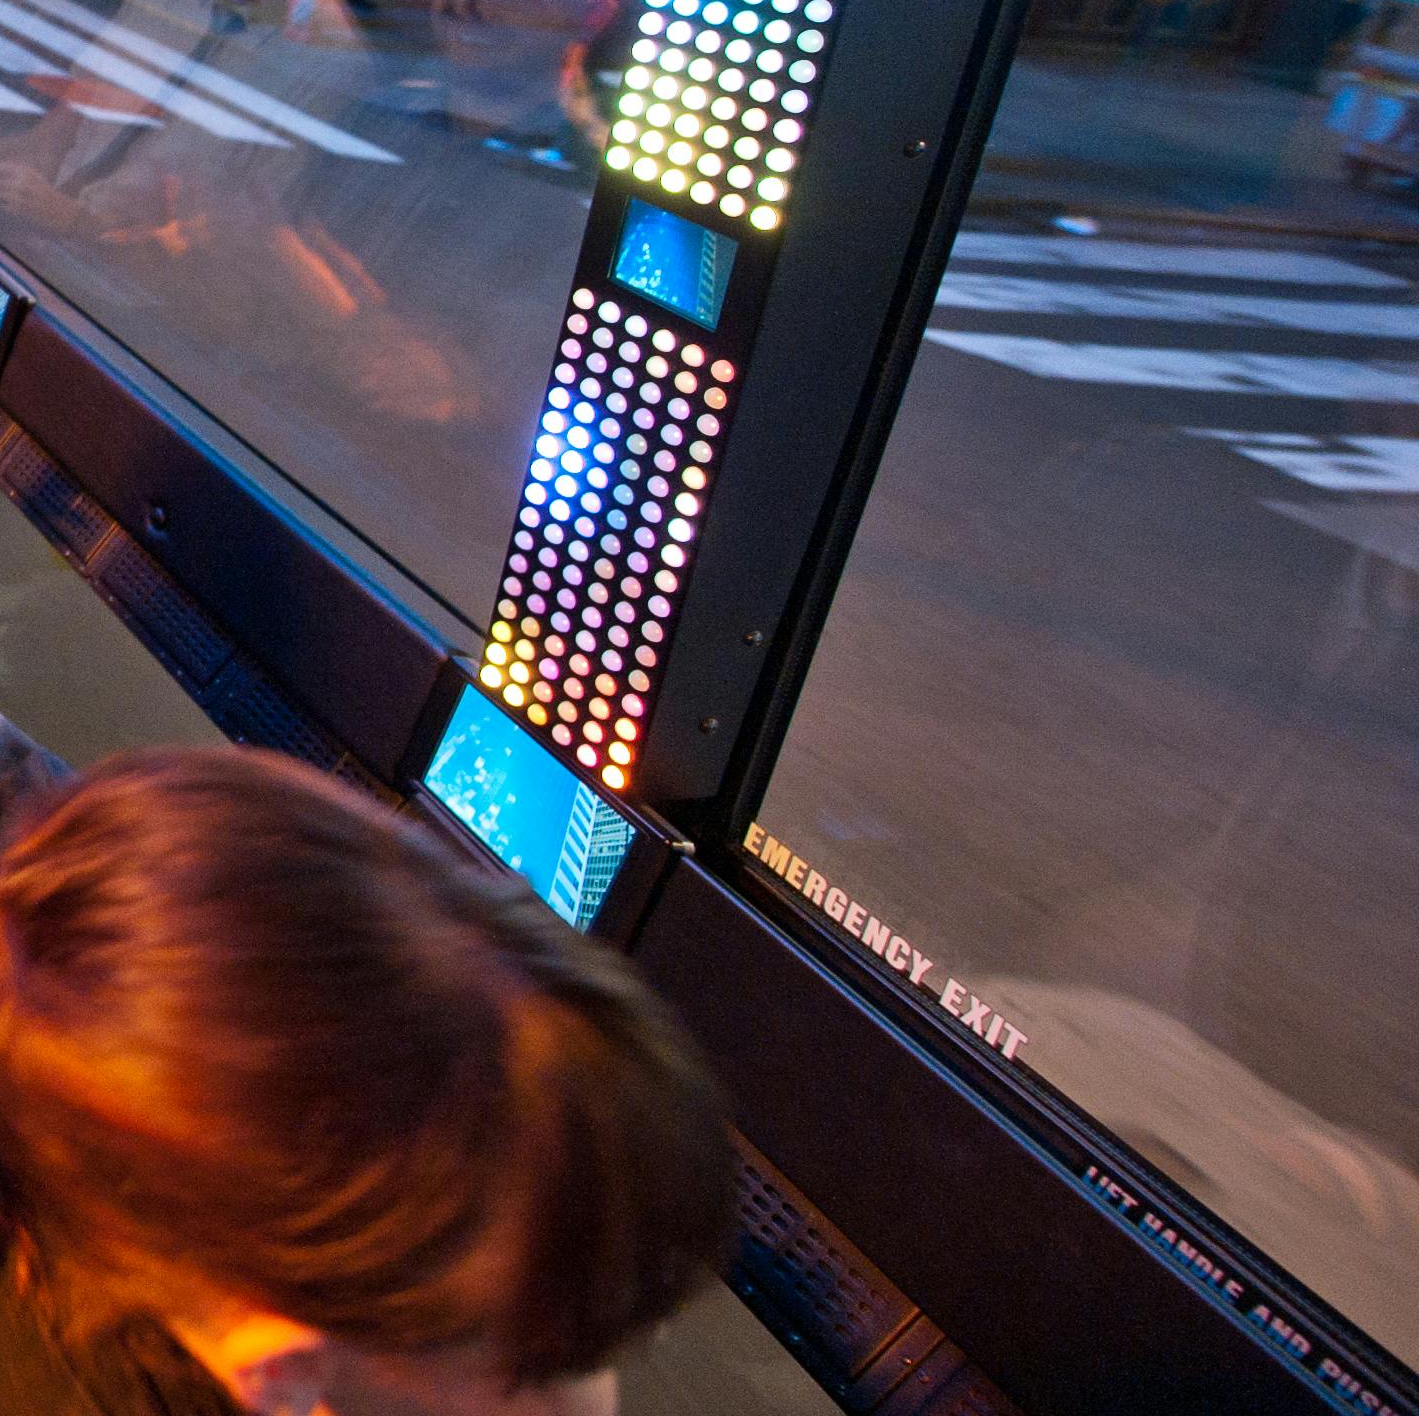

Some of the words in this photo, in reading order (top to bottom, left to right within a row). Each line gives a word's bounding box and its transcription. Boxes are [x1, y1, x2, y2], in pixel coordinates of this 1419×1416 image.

[743, 821, 933, 984] EMERGENCY
[939, 977, 1028, 1059] EXIT
[1081, 1165, 1139, 1214] LIFT
[1138, 1212, 1244, 1304] HANDLE
[1248, 1304, 1311, 1360] AND
